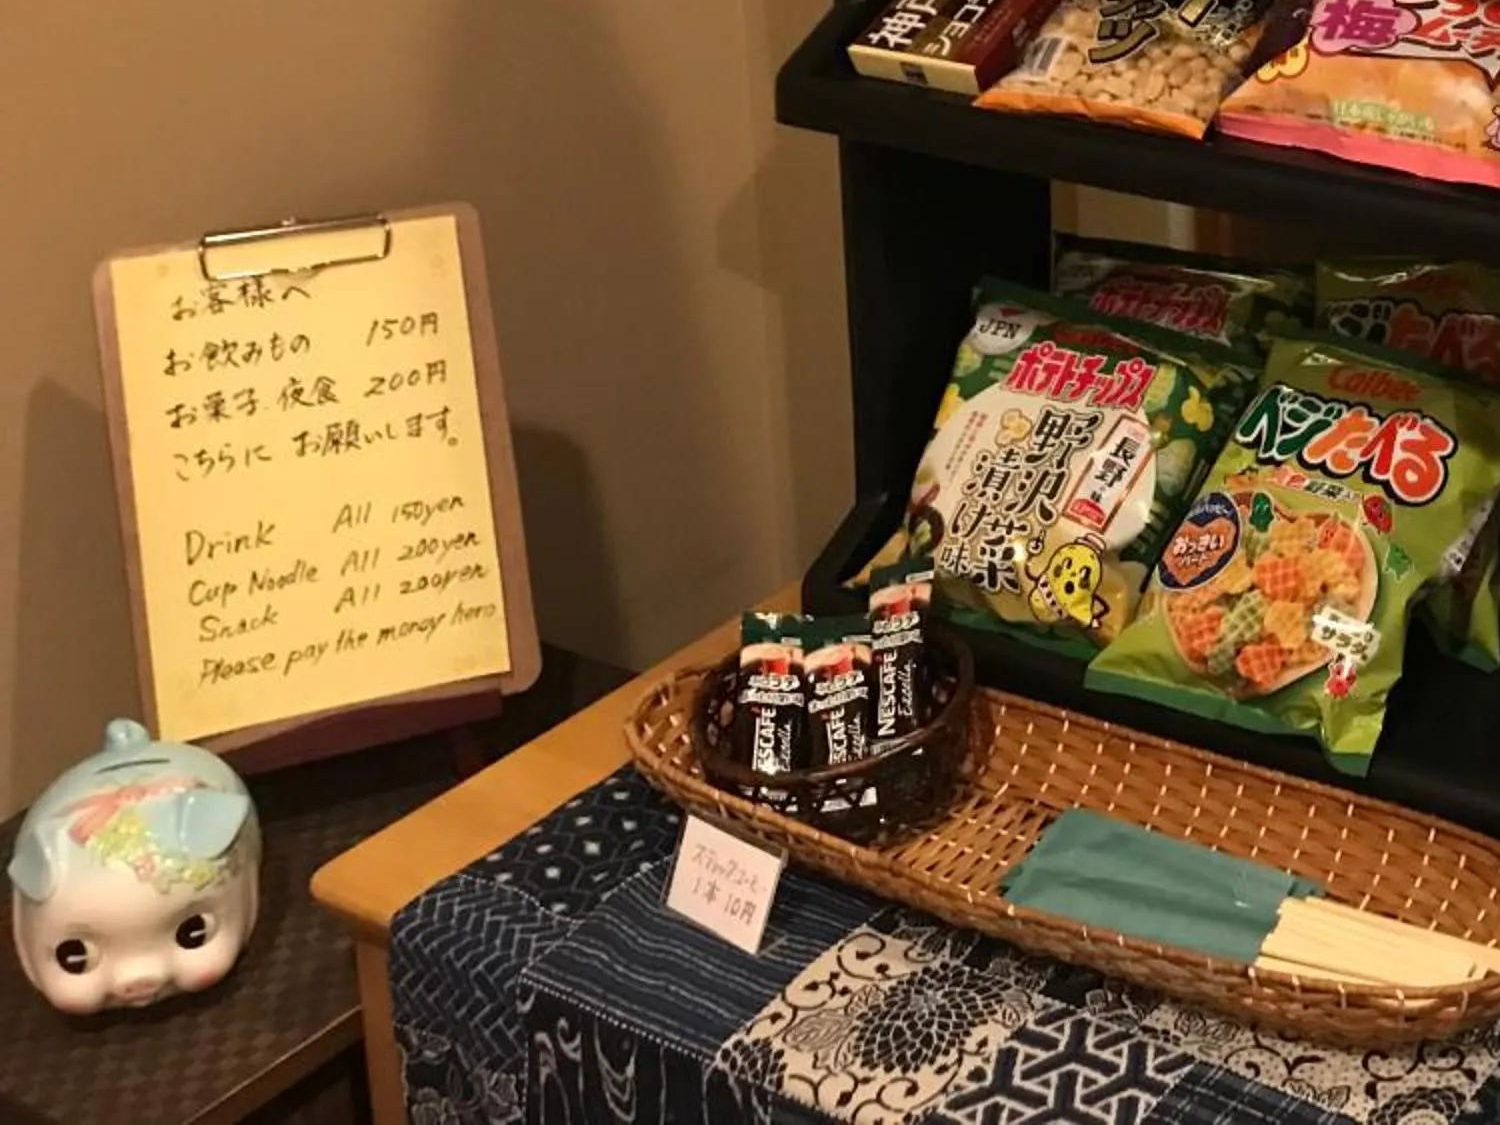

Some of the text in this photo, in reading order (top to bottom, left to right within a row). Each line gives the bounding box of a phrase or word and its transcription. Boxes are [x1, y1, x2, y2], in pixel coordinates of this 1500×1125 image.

[170, 277, 312, 322] お客様へ
[977, 318, 1022, 341] JPN
[163, 311, 440, 377] お飲みもの 150円
[363, 359, 448, 399] 200円
[1008, 341, 1158, 410] ポテトチップス
[1235, 383, 1457, 504] ベジたべる
[184, 521, 276, 566] Drink
[332, 501, 372, 533] All
[188, 579, 238, 607] Cup
[248, 558, 319, 595] Noodle
[340, 547, 380, 577] All
[198, 604, 279, 643] Snack
[334, 583, 381, 613] All
[283, 642, 329, 676] pay
[335, 628, 369, 654] the
